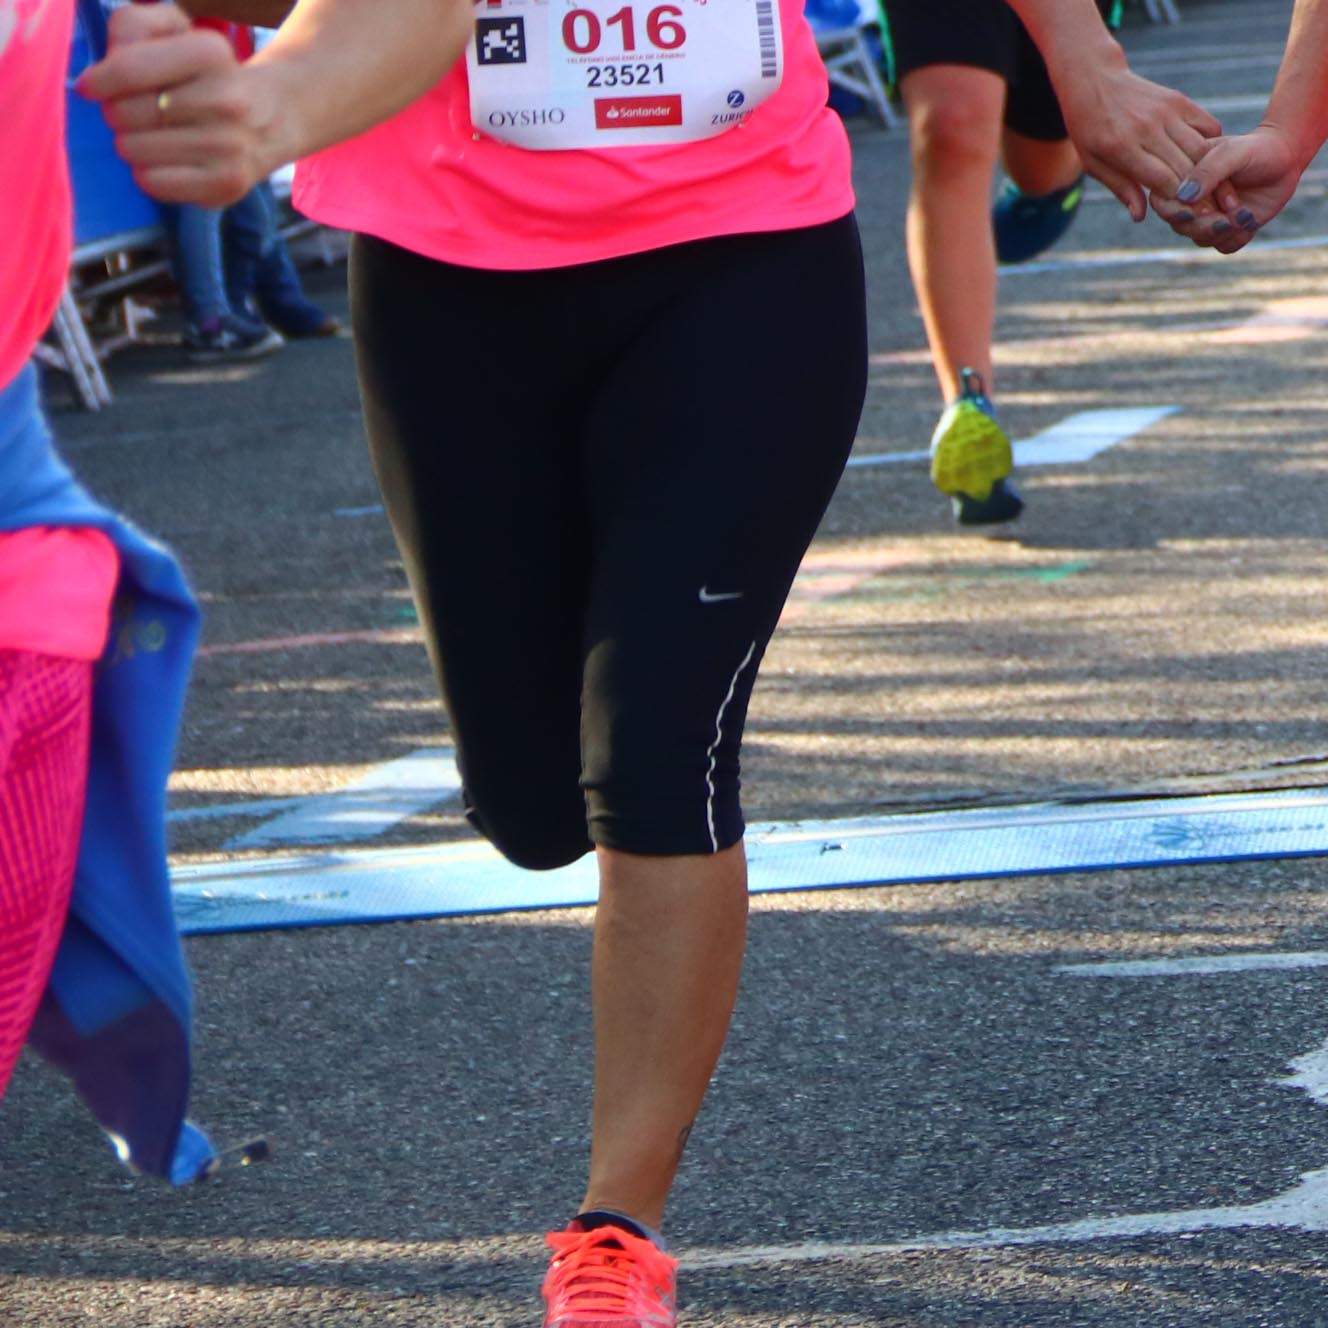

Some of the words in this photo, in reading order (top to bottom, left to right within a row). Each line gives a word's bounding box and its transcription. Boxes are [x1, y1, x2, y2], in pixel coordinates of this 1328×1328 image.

[562, 5, 687, 54] 016
[587, 63, 664, 88] 23521
[489, 108, 565, 128] OYSHO
[619, 106, 671, 118] Santander
